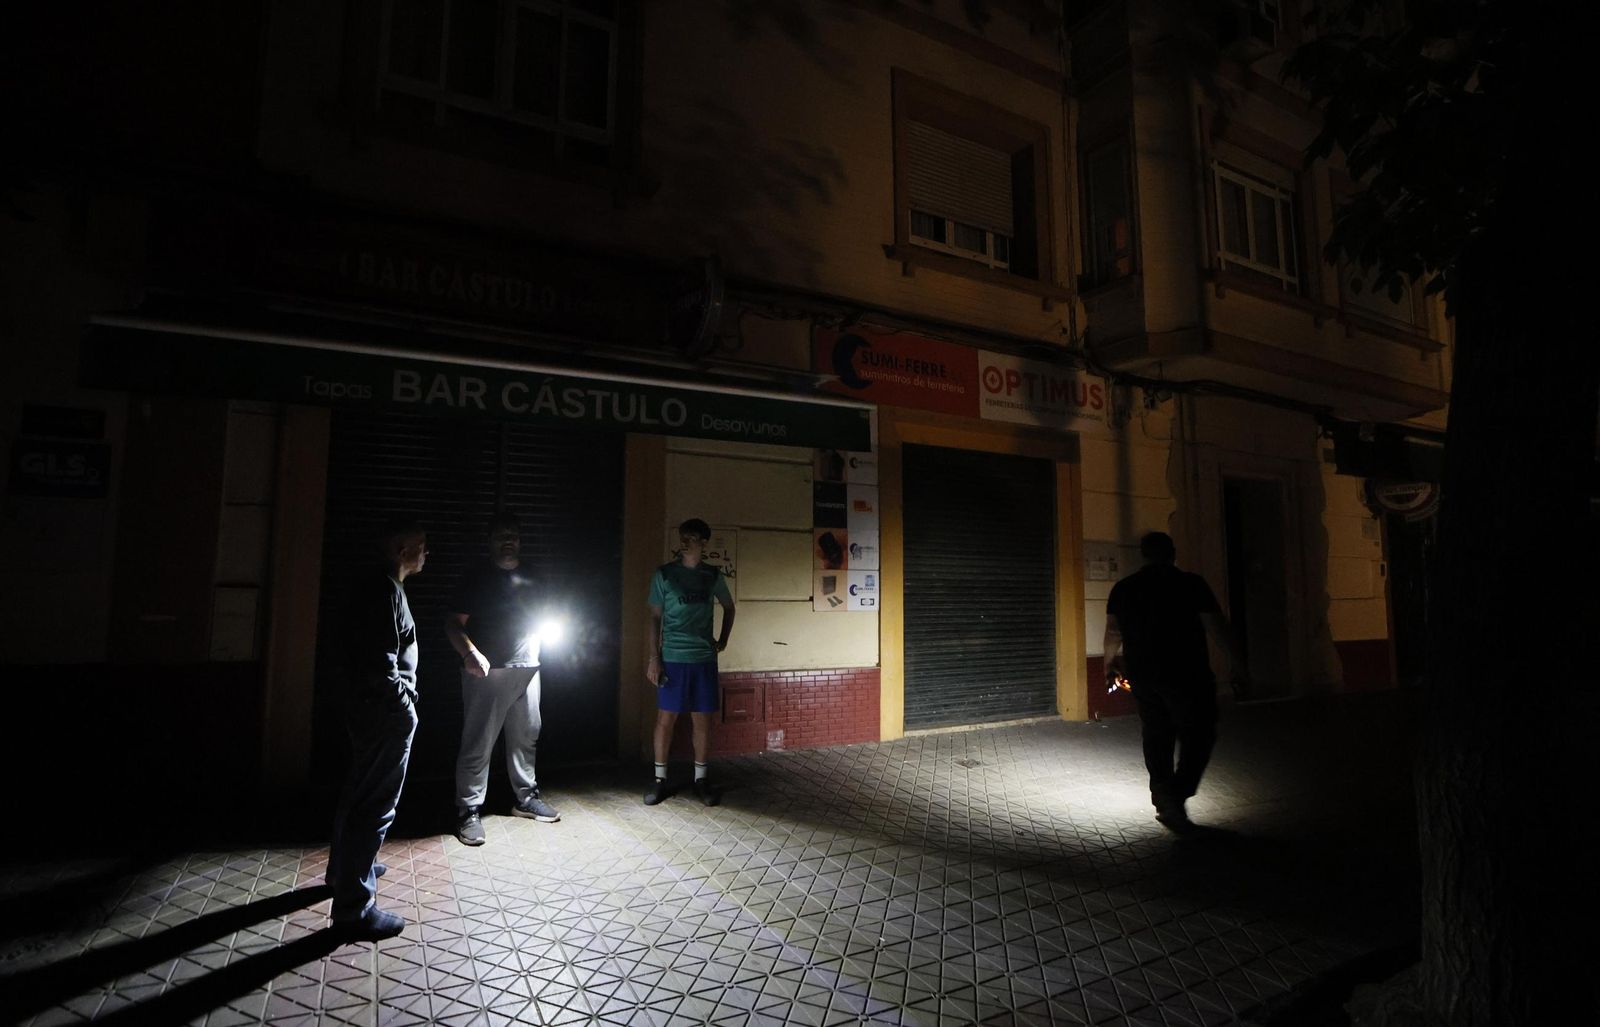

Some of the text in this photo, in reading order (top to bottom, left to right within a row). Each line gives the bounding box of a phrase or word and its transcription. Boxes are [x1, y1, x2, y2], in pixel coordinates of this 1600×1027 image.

[358, 250, 420, 293] BAR
[861, 350, 948, 378] SUMI-FERRE
[861, 370, 912, 385] suministros
[913, 377, 925, 388] de
[303, 368, 787, 438] Tapas BAR CÁSTULO Desayunos
[982, 365, 1104, 410] OPTIMUS
